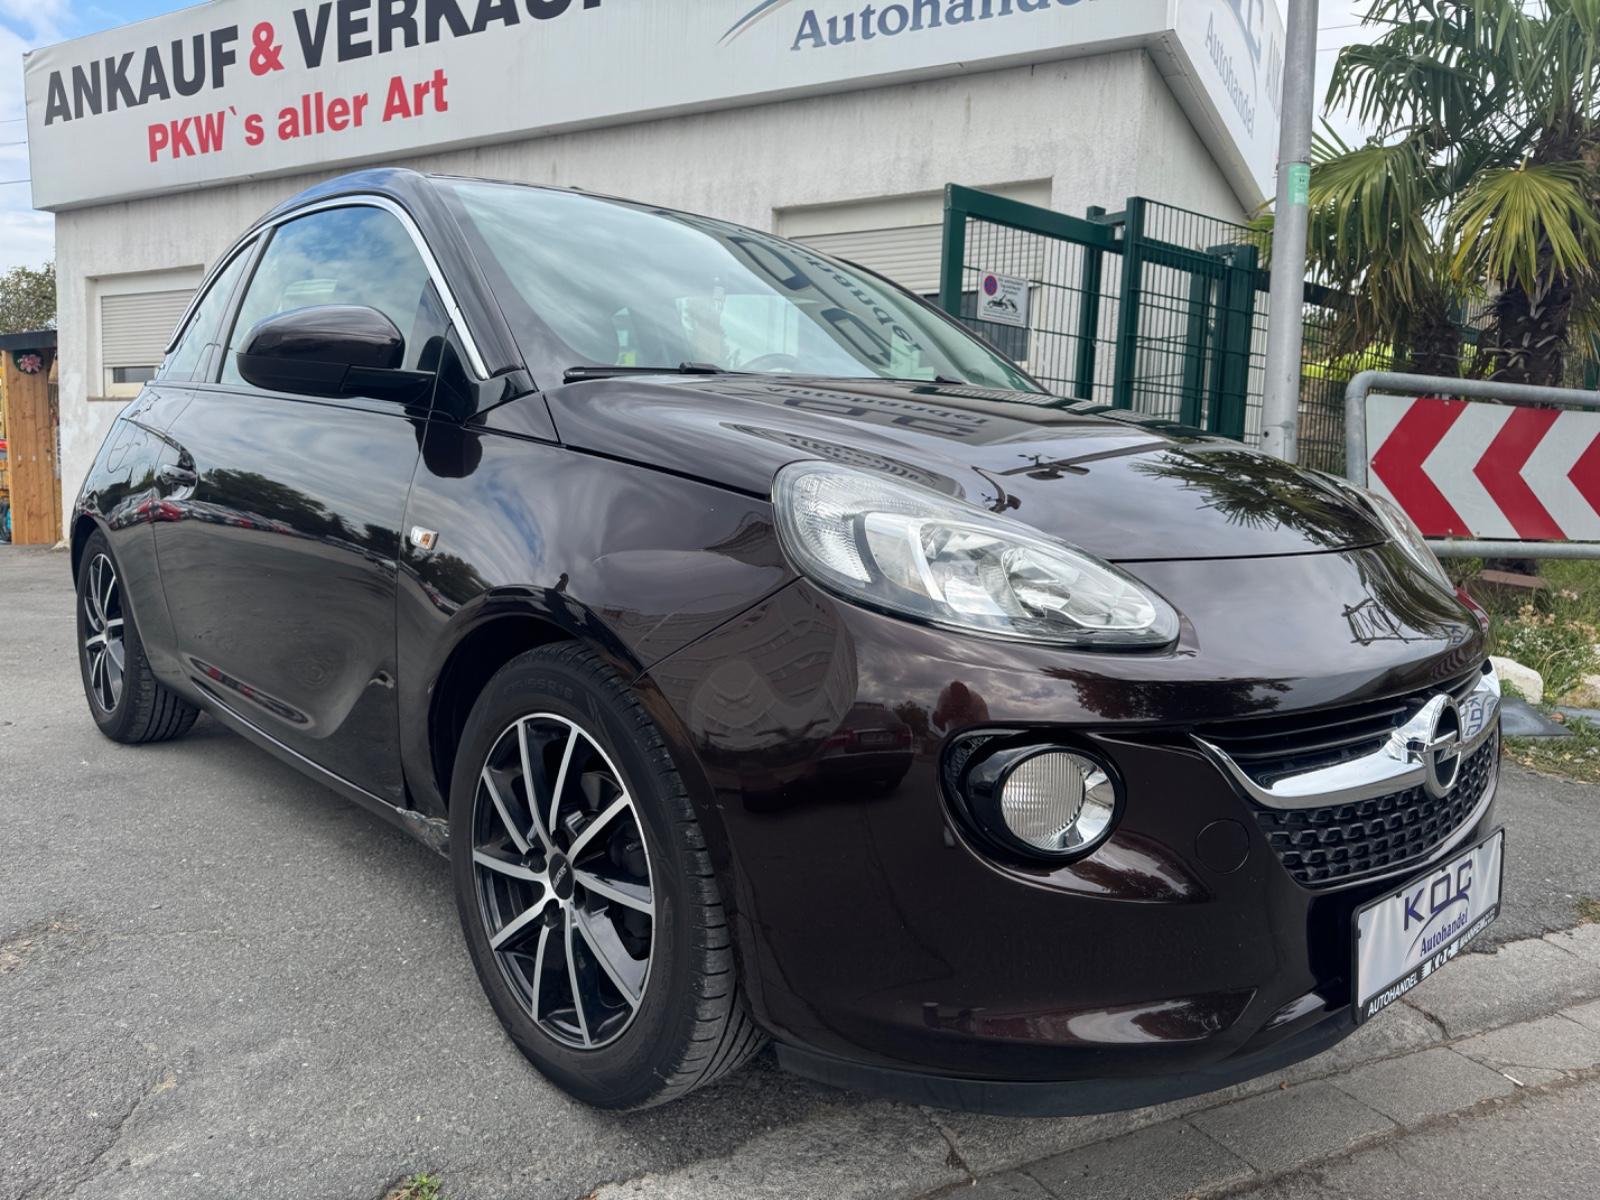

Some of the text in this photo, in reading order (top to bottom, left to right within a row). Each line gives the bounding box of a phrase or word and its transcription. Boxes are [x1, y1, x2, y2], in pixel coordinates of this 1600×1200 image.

[790, 0, 1096, 51] Autohan
[44, 0, 601, 126] ANKAUF & VERKA
[277, 92, 368, 141] aller
[382, 69, 449, 123] Art
[1419, 906, 1469, 957] Autohandel
[1366, 972, 1419, 1018] AUTOHANDEL
